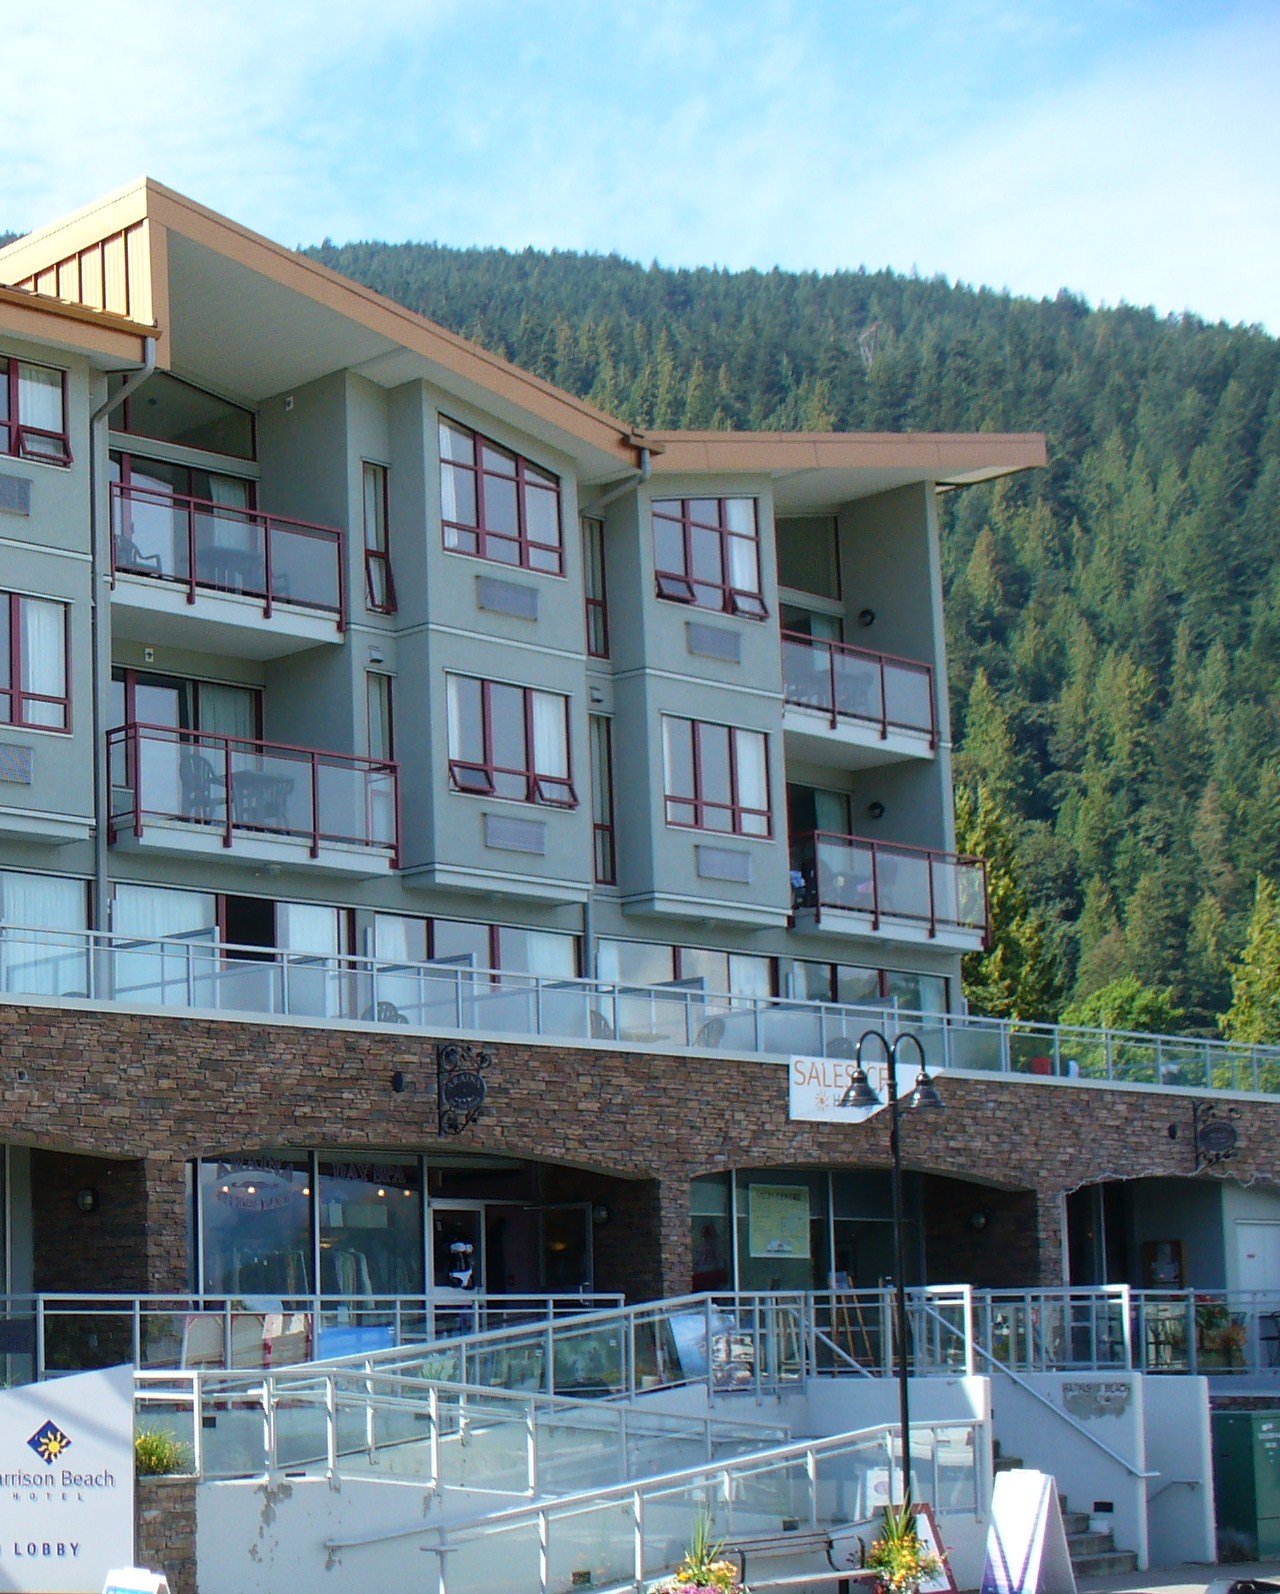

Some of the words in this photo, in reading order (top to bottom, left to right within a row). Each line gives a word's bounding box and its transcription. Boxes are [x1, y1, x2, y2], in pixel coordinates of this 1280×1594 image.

[61, 1469, 114, 1488] Beach
[12, 1492, 83, 1501] HOTEL
[13, 1542, 81, 1557] LOBBY
